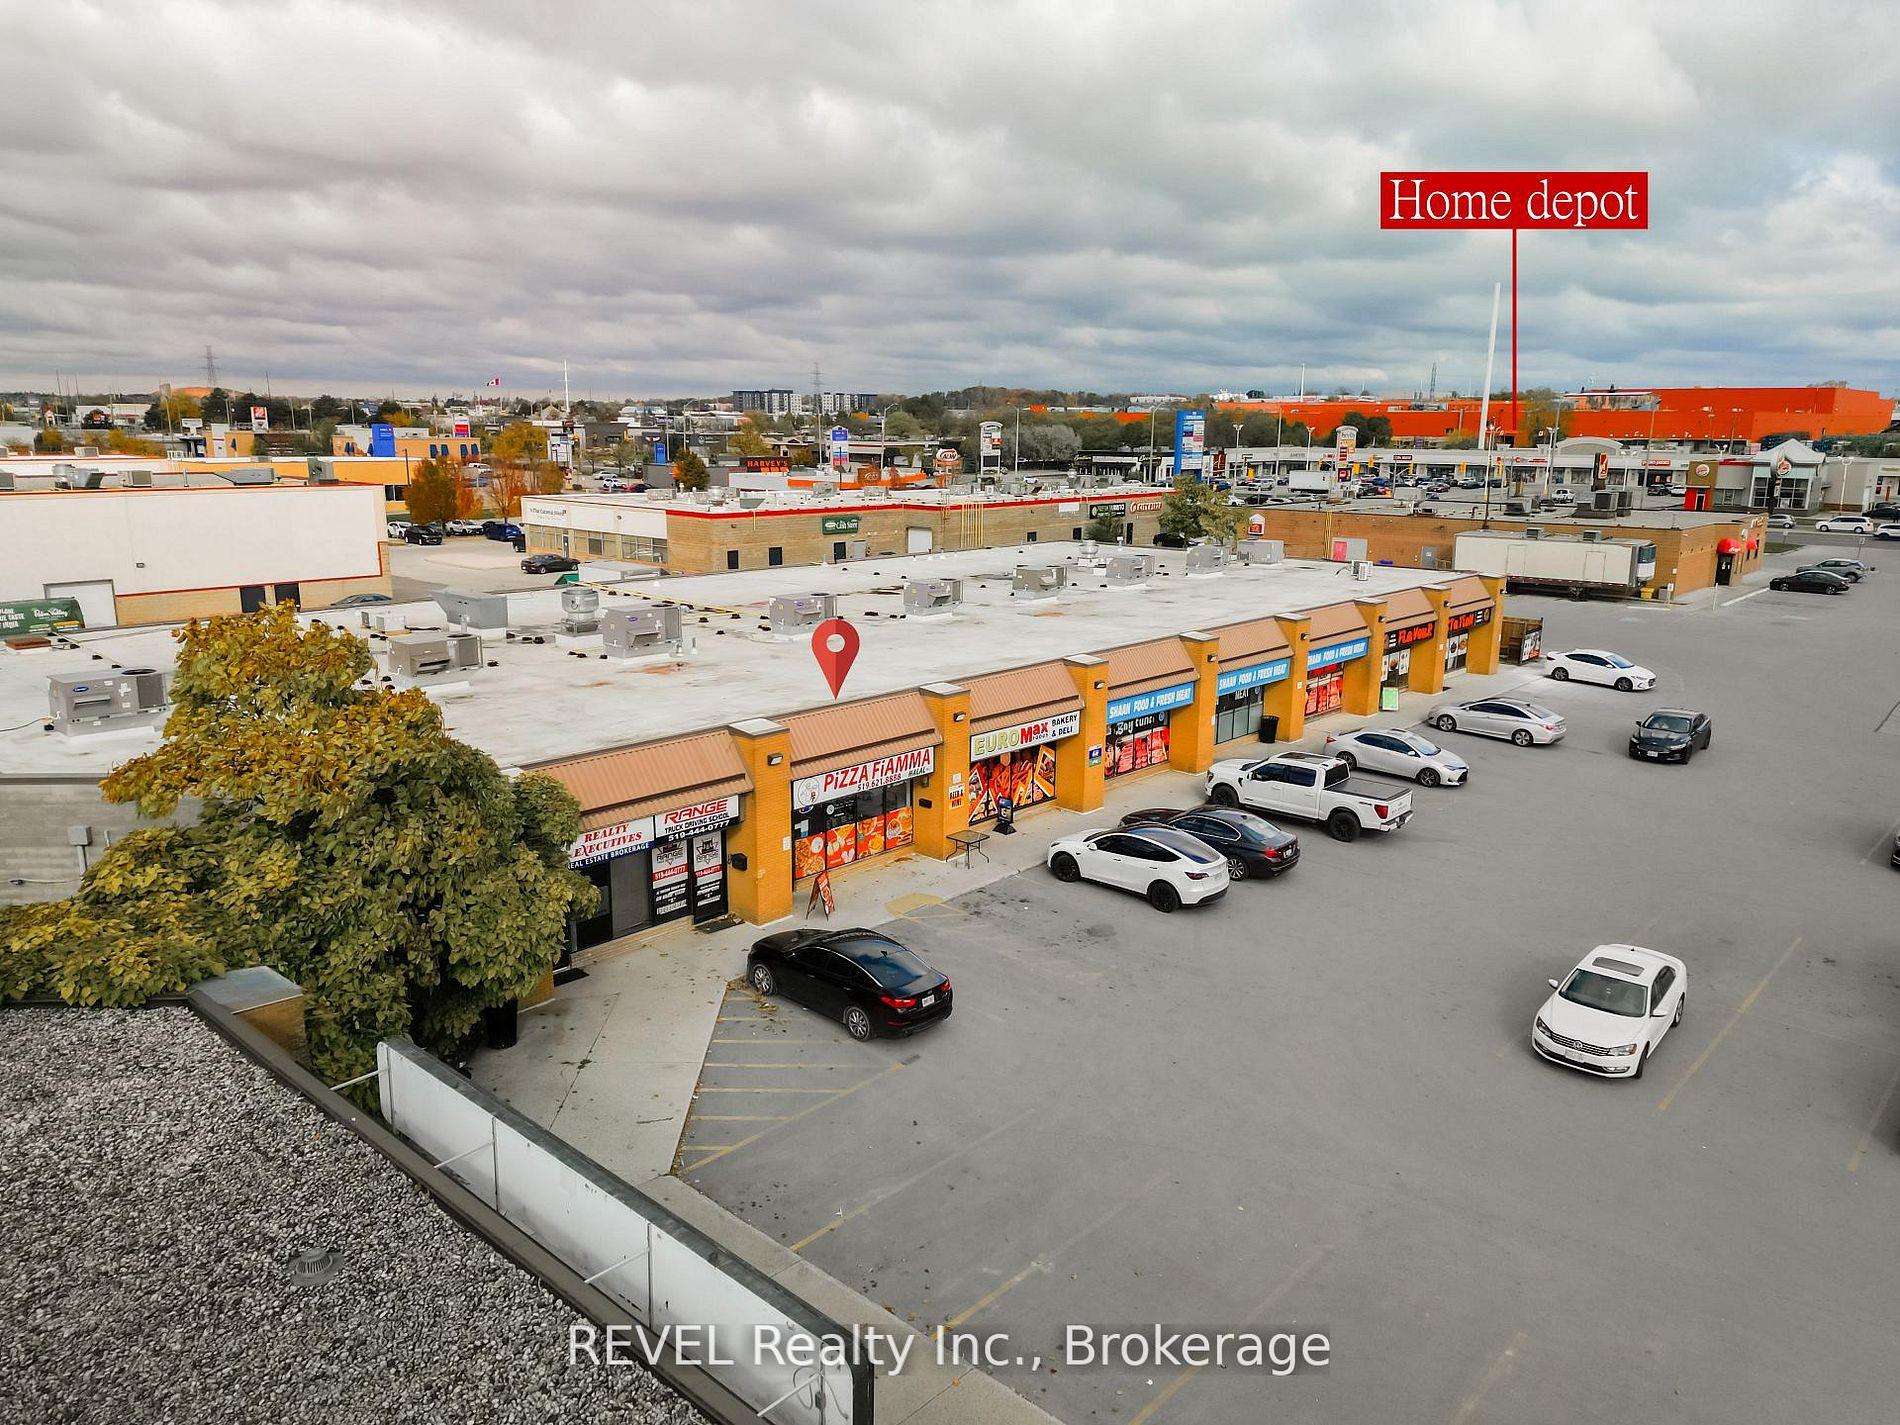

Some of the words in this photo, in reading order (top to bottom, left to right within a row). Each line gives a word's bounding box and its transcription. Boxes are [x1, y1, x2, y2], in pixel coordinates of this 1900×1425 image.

[1257, 666, 1274, 681] FRESH
[1273, 663, 1288, 677] MEAT
[1109, 702, 1131, 719] SHAAN
[1133, 697, 1150, 713] FOOD
[1156, 692, 1176, 707] FRESH
[1175, 687, 1192, 702] MEAT
[1051, 714, 1078, 727] BAKERY
[1051, 729, 1057, 738] &
[1058, 726, 1073, 736] DELI
[664, 799, 729, 825] RANGE
[664, 824, 684, 834] TRUCK
[684, 818, 708, 829] DRIVING
[708, 812, 730, 823] SCHOOL
[584, 823, 629, 843] REALTY
[668, 820, 730, 842] 519-444-0777
[574, 831, 643, 857] EXECUTIVES
[585, 852, 609, 865] ESTATE
[610, 841, 649, 858] BROKERAGE
